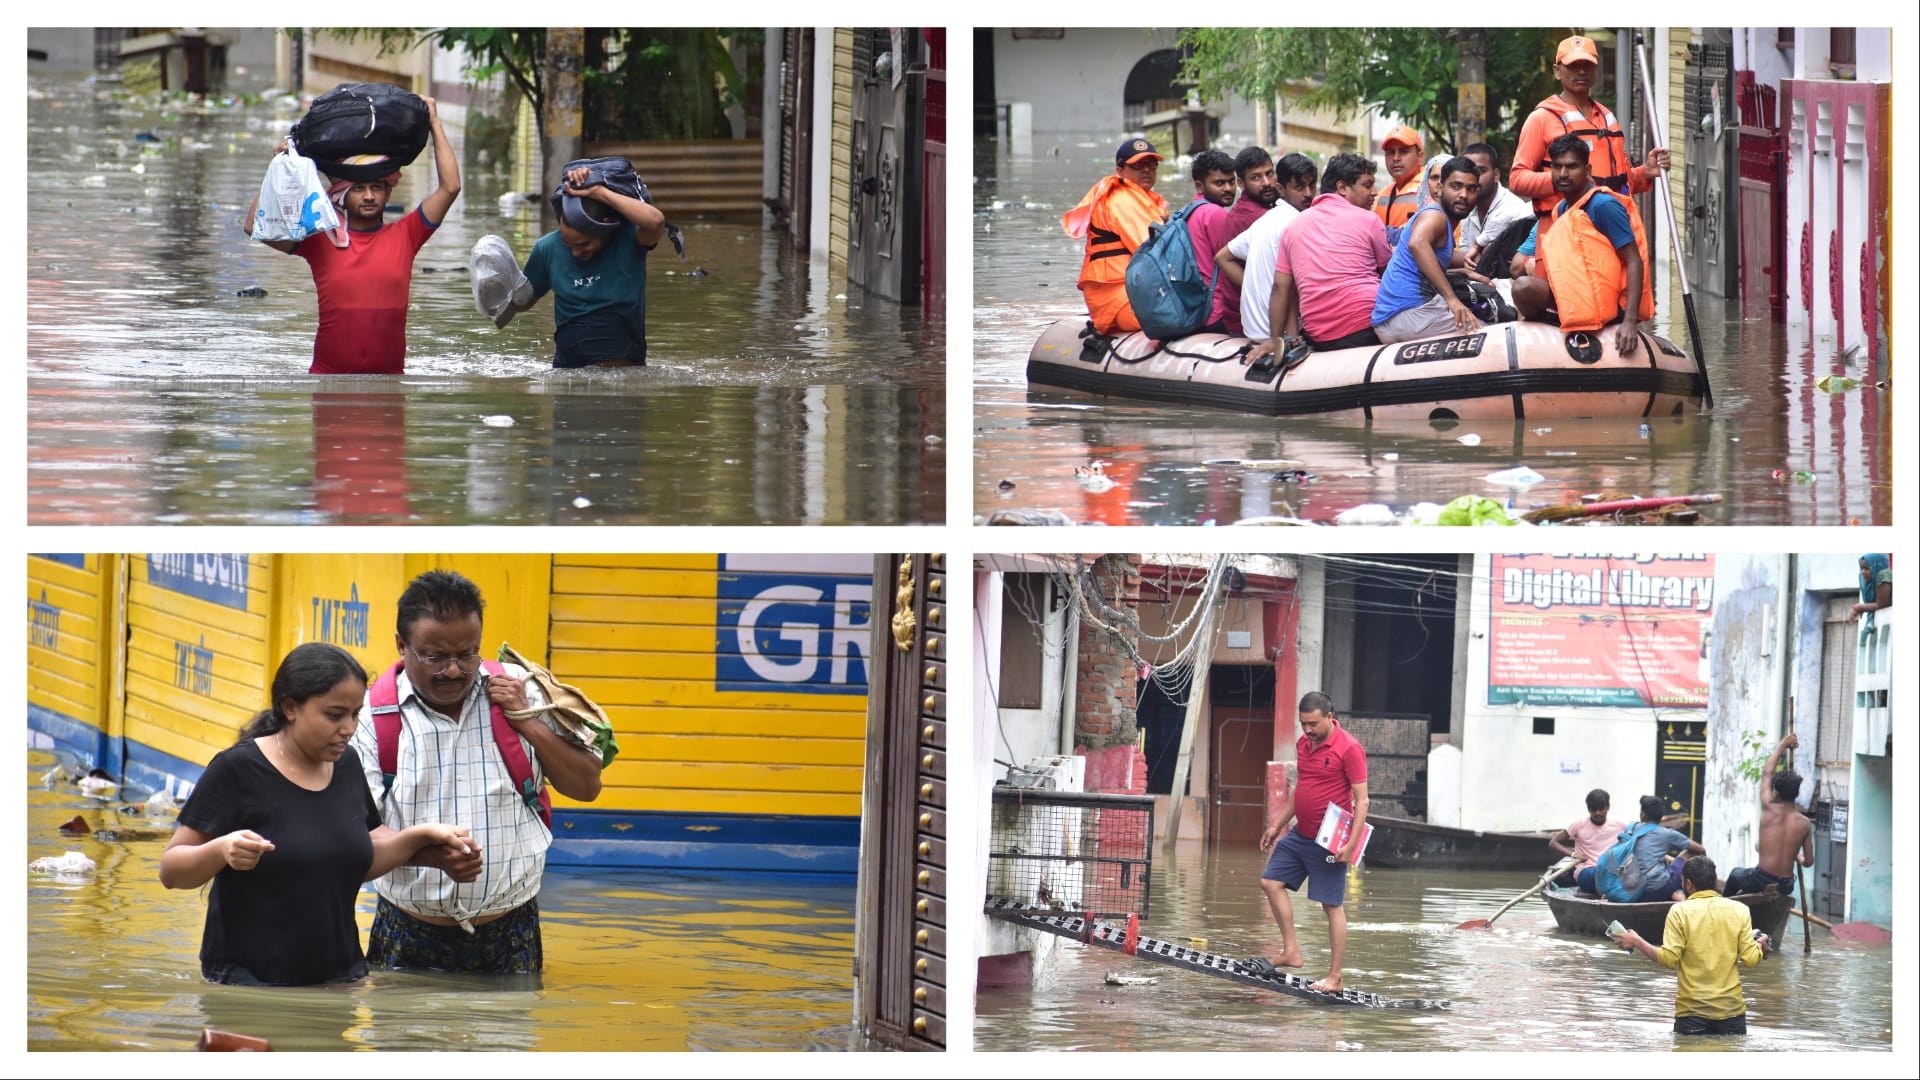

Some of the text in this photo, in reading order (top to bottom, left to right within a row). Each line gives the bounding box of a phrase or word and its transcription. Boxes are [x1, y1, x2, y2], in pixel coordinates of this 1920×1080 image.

[1403, 337, 1480, 359] GEE PEE
[1503, 567, 1714, 611] Digital Library
